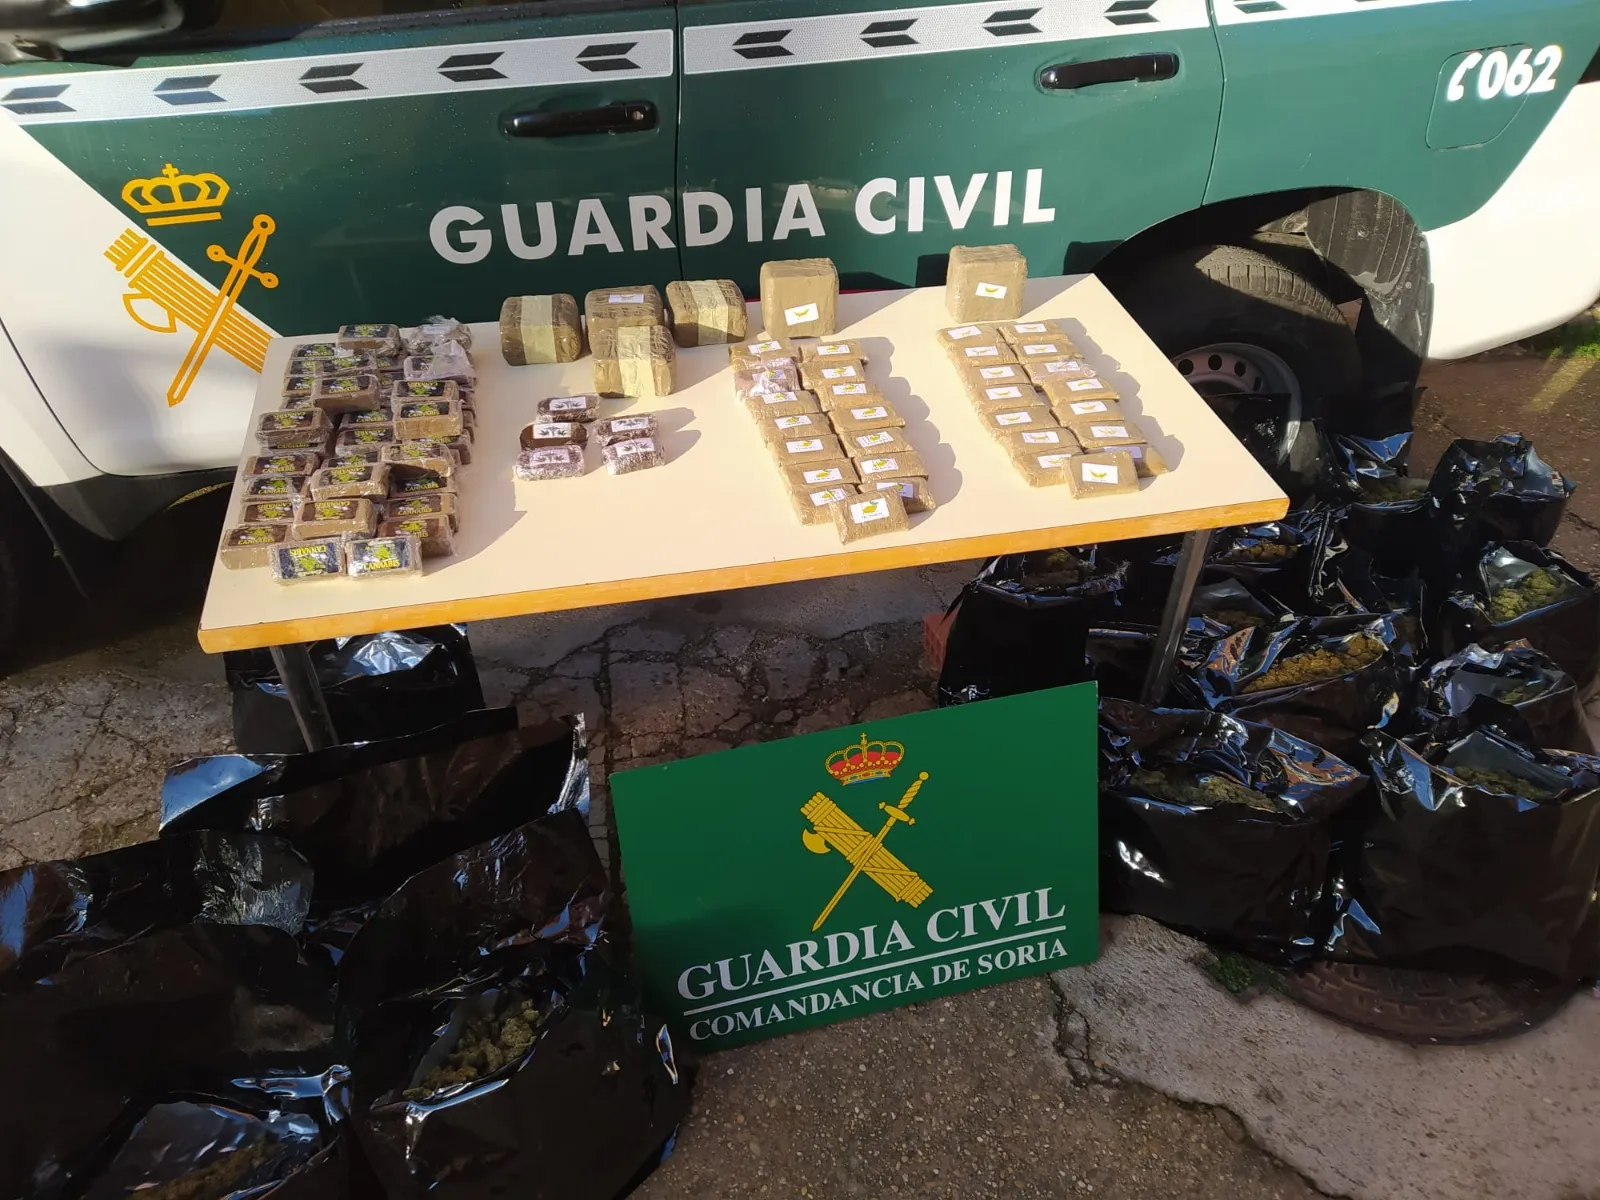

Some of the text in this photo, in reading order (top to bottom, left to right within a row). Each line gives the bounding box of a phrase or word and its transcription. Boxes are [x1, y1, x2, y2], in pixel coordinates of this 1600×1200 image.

[1478, 44, 1562, 100] 062
[429, 168, 1056, 265] GUARDIA CIVIL
[289, 545, 327, 556] CANNABIS
[363, 559, 400, 570] CANNABIS
[677, 887, 1066, 1001] GUARDIA CIVIL
[689, 938, 1068, 1042] COMANDANCIA DE SORIA
